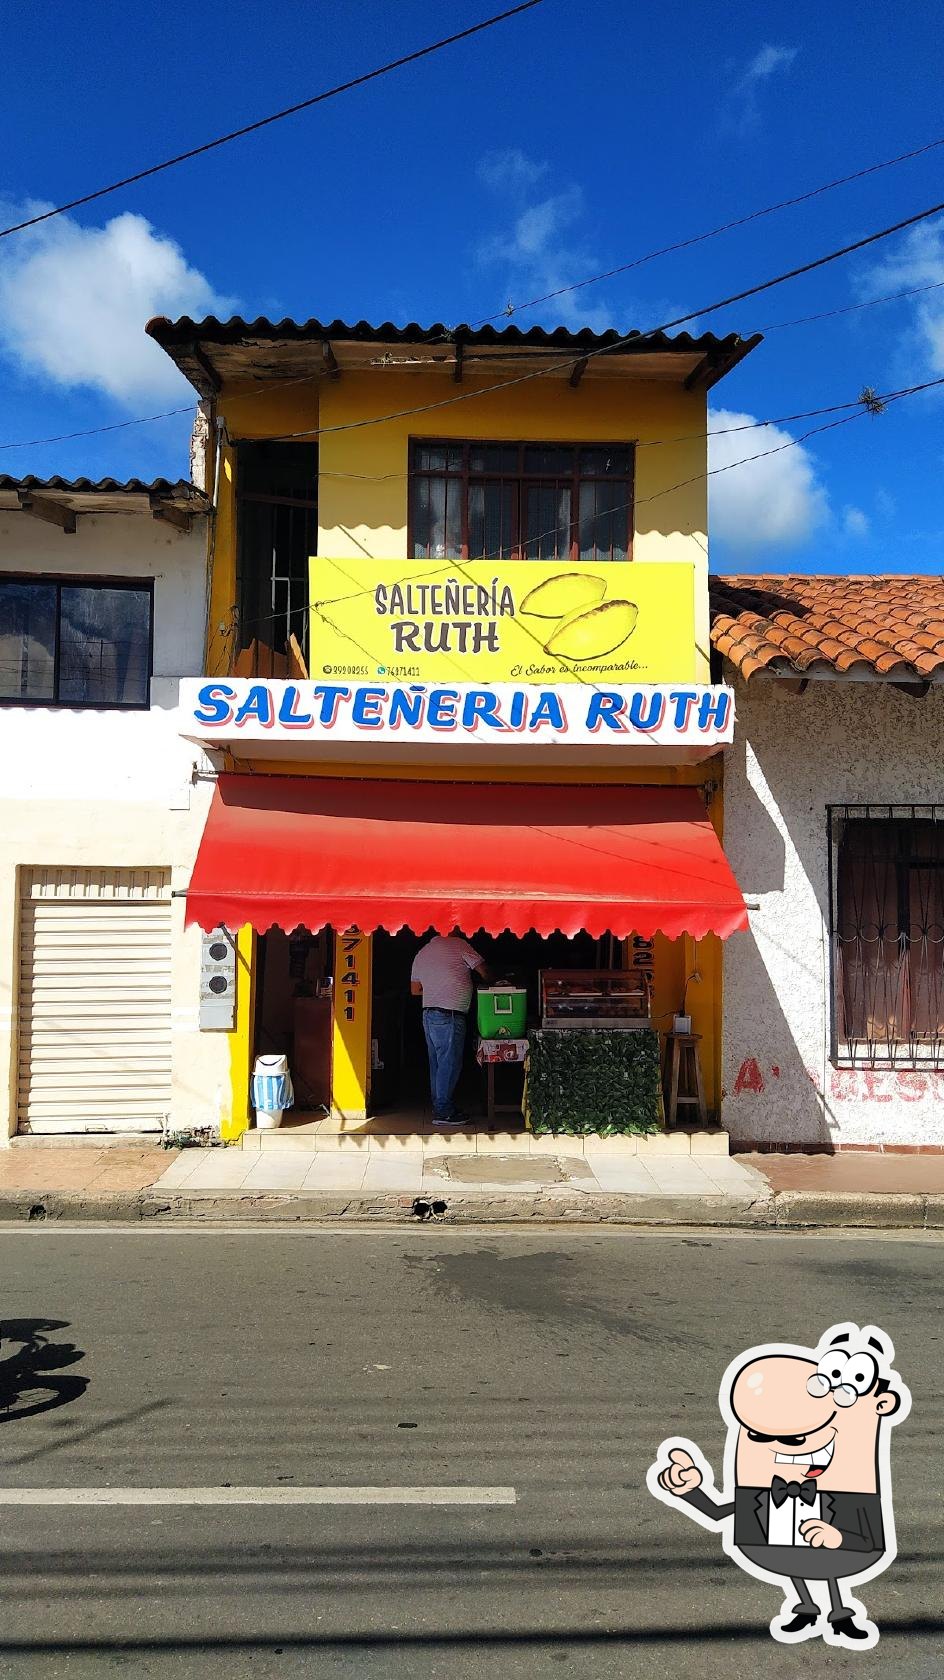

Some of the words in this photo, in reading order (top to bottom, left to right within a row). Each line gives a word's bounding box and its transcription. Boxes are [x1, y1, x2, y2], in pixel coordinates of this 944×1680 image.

[375, 577, 514, 617] SALTEÑERÍA
[391, 621, 500, 654] RUTH
[511, 664, 522, 676] El
[525, 663, 556, 676] Sabor
[193, 683, 568, 733] SALTEÑERIA
[585, 691, 728, 734] RUTH
